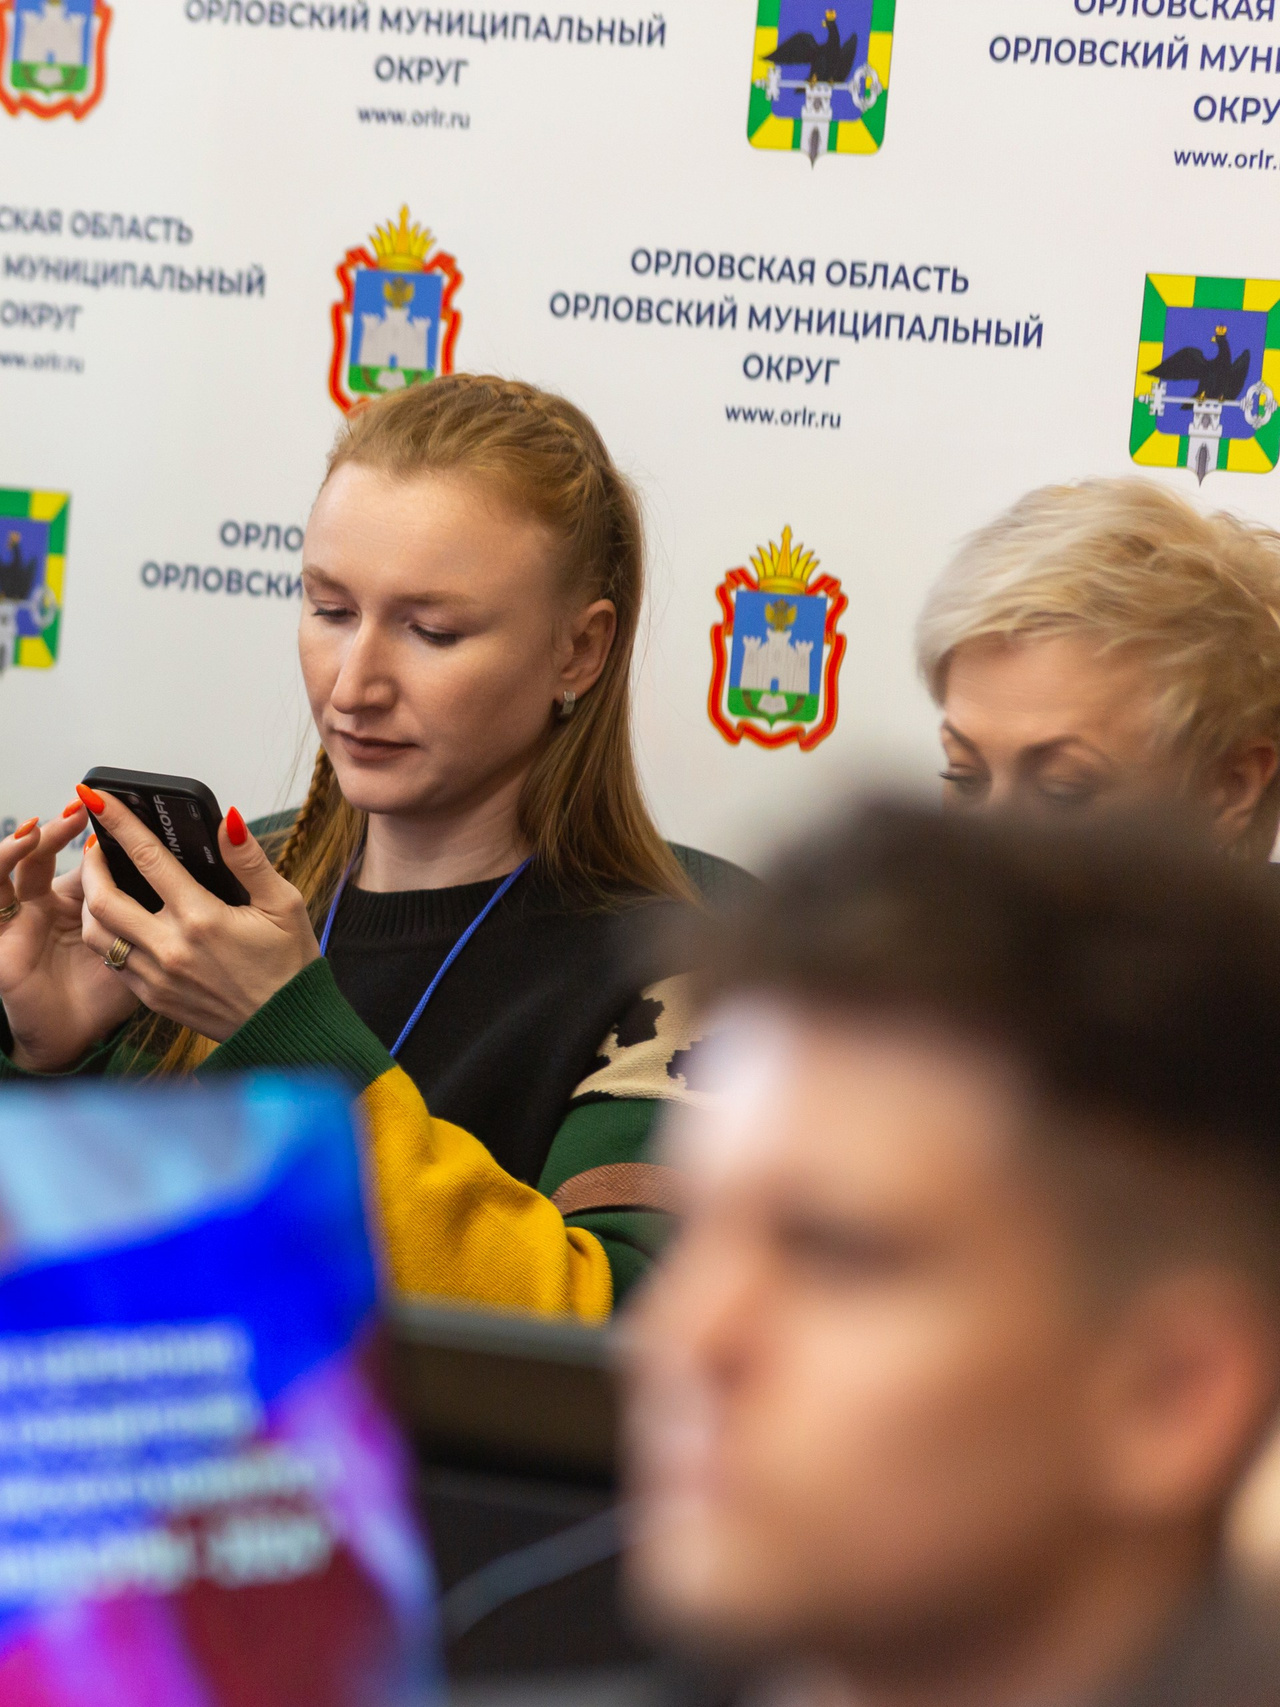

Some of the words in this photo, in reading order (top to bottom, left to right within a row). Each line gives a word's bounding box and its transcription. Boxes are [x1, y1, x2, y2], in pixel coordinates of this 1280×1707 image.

[185, 0, 370, 32] ОРЛОВСКИЙ
[380, 8, 666, 47] МУНИЦИПАЛЬНЫЙ
[374, 55, 468, 86] ОКРУГ
[989, 35, 1188, 70] ОРЛОВСКИЙ
[1200, 44, 1280, 74] МУН
[358, 108, 470, 129] www.orlr.ru
[1174, 149, 1280, 170] www.orlr.
[69, 210, 193, 246] ОБЛАСТЬ
[2, 255, 266, 298] МУНИЦИПАЛЬНЫЙ
[631, 248, 815, 285] ОРЛОВСКАЯ
[826, 260, 969, 294] ОБЛАСТЬ
[550, 292, 737, 329] ОРЛОВСКИЙ
[748, 305, 1043, 348] МУНИЦИПАЛЬНЫЙ
[743, 353, 840, 385] ОКРУГ
[726, 406, 841, 428] www.orlr.ru
